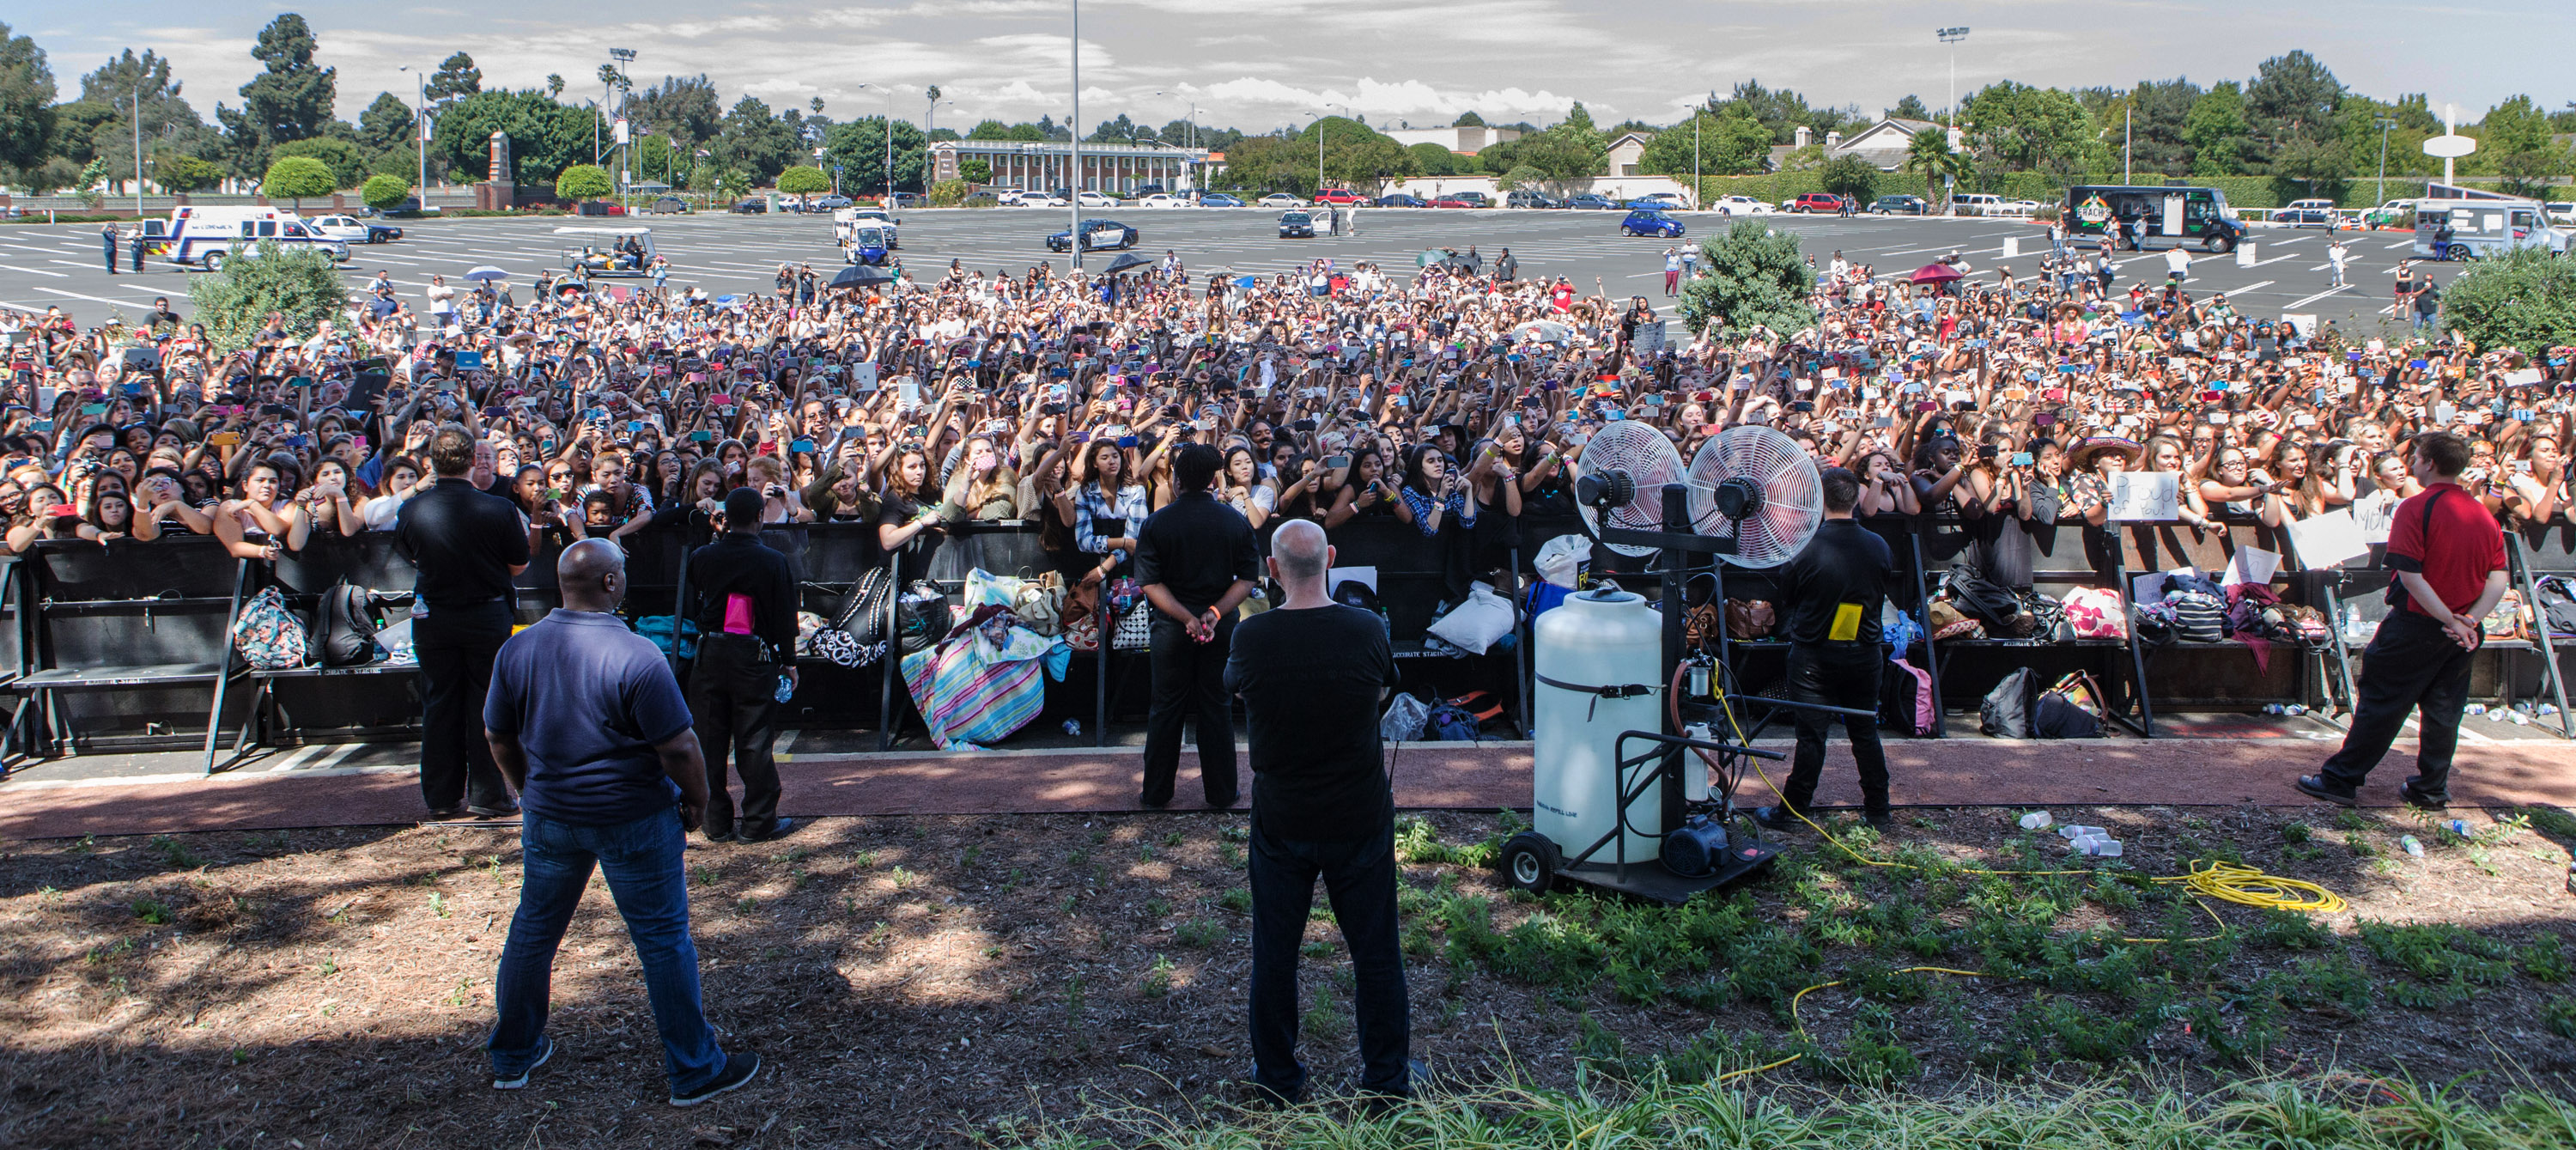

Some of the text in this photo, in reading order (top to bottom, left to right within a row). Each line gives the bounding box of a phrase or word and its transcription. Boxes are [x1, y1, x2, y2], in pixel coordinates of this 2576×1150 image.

[2076, 206, 2112, 219] FRACH'S
[2116, 475, 2173, 502] Proud
[2113, 499, 2165, 517] of You!
[317, 666, 382, 677] ACURATE STAGING
